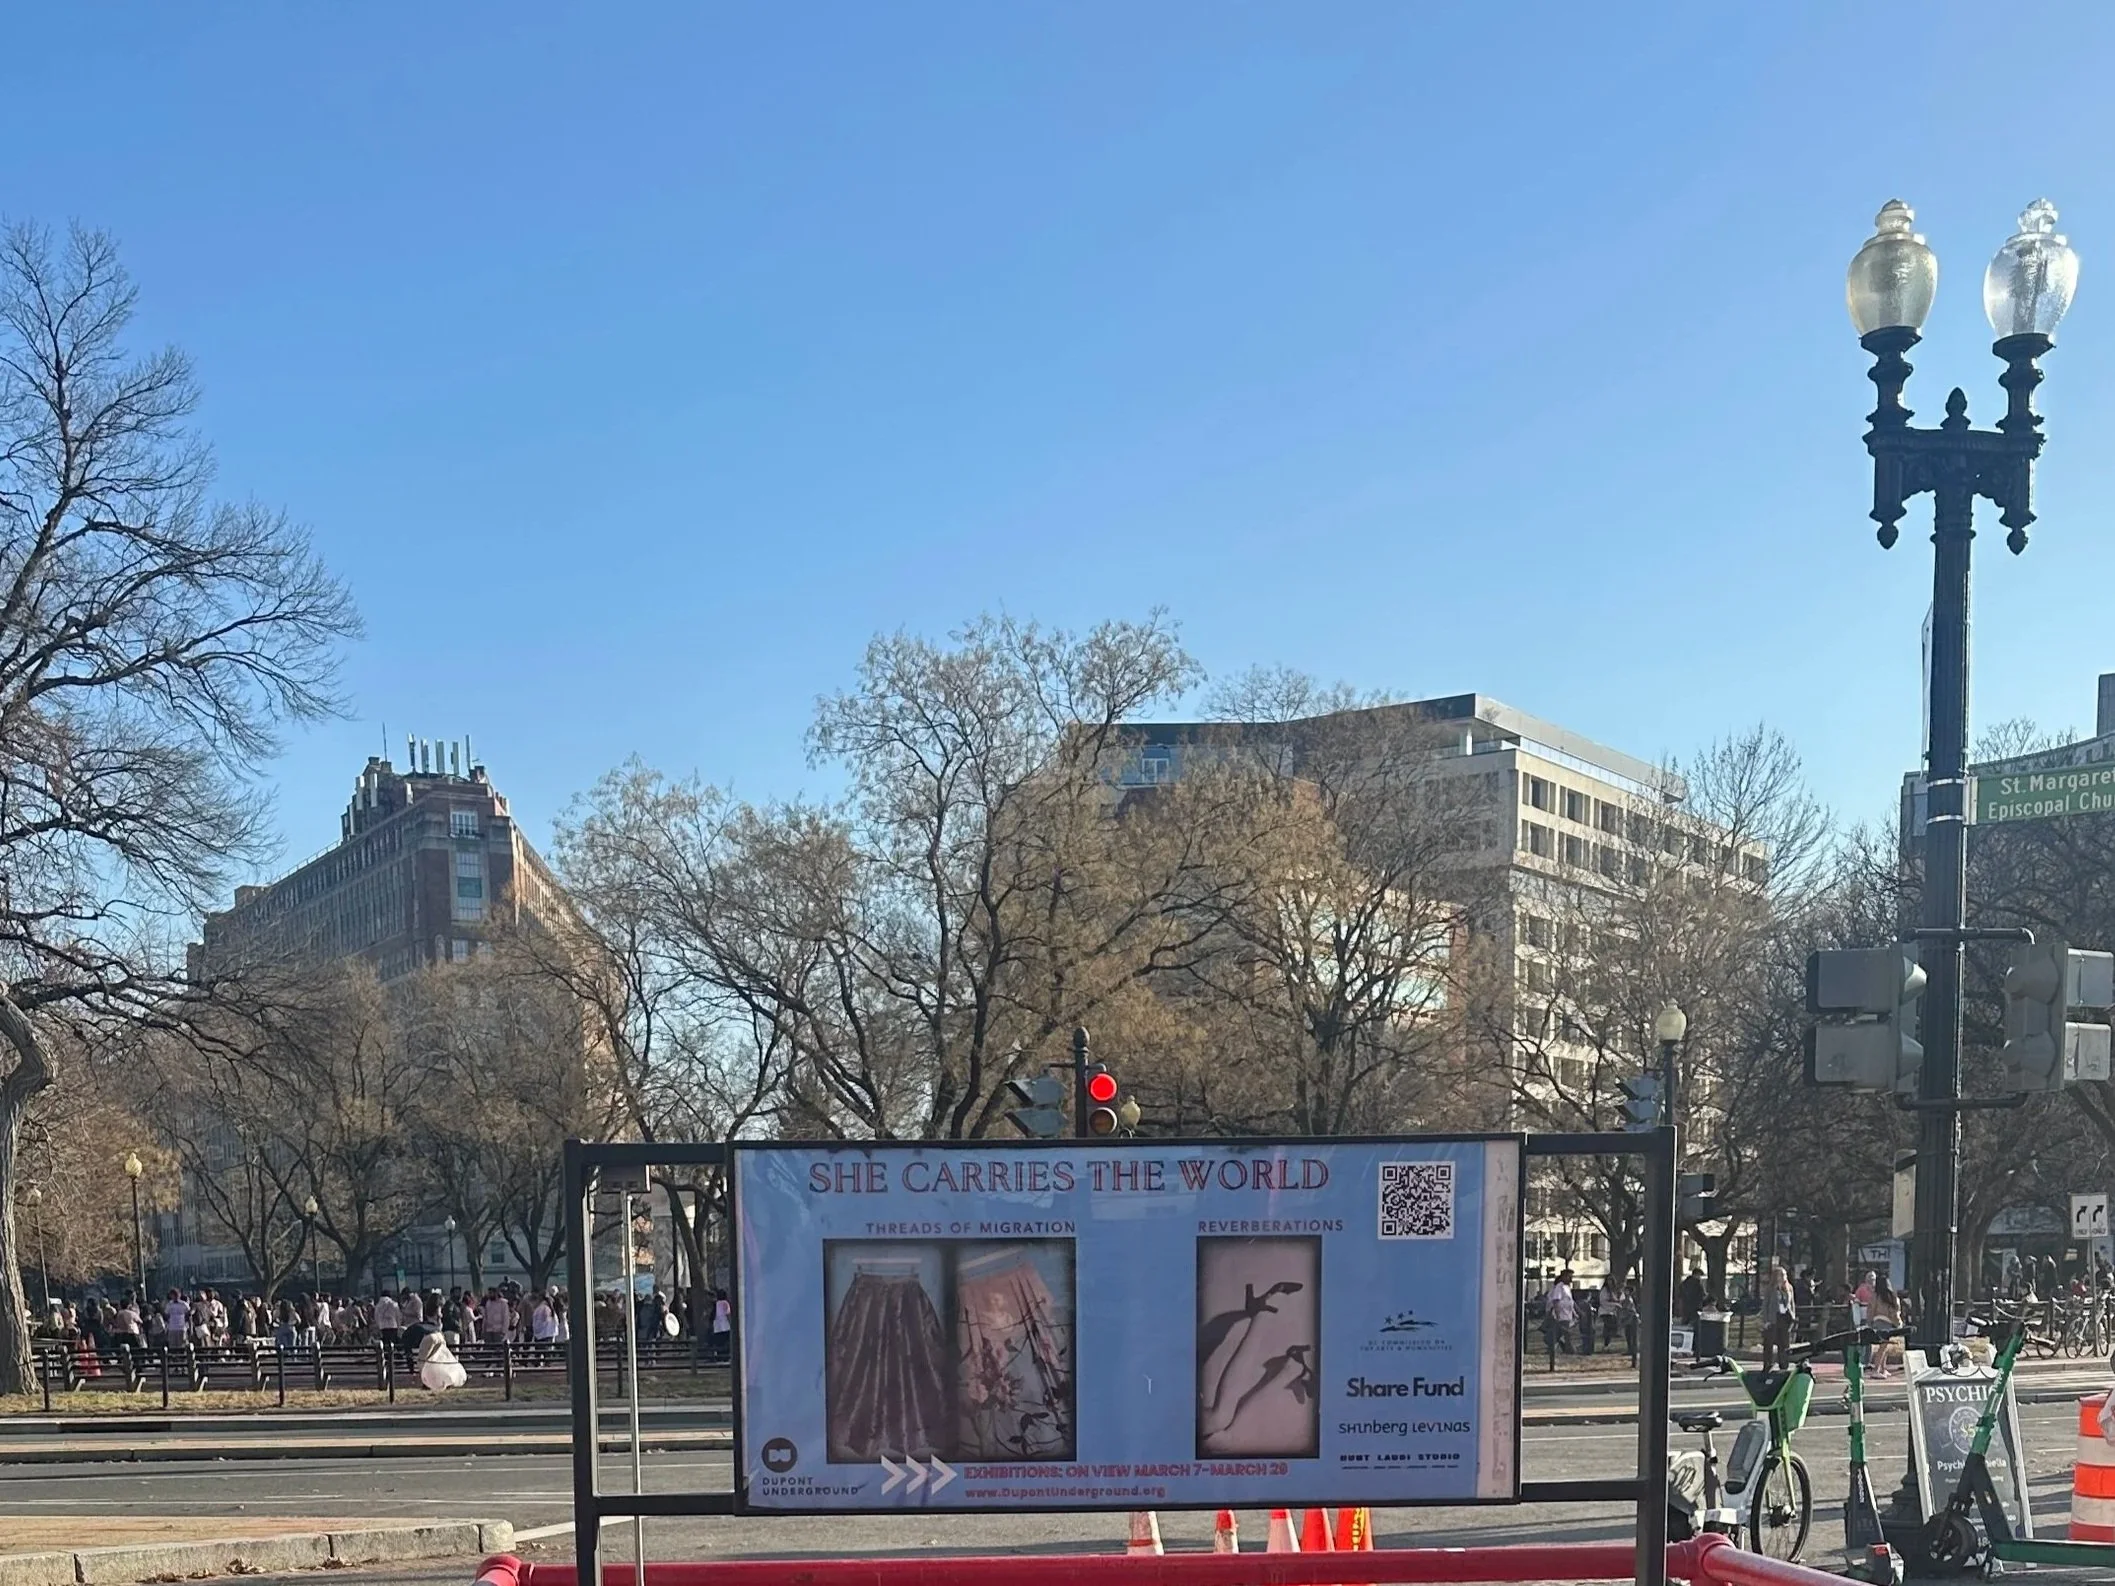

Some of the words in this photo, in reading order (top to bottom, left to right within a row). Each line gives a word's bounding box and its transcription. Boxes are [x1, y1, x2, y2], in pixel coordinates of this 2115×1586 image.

[2000, 777, 2026, 796] St.
[1988, 794, 2070, 822] Episcopal
[2079, 791, 2115, 810] Chu
[808, 1161, 889, 1194] SHE
[901, 1160, 1076, 1193] CARRIES
[1087, 1159, 1166, 1192] THE
[1178, 1158, 1330, 1191] WORLD
[866, 1222, 942, 1235] THREADS
[950, 1222, 971, 1235] OF
[979, 1220, 1076, 1234] MIGRATION
[1198, 1219, 1344, 1233] REVERBERATIONS
[1346, 1377, 1409, 1398] Share
[1413, 1376, 1465, 1397] Fund
[963, 1465, 1063, 1480] EXHIBITIONS:
[1066, 1465, 1089, 1479] ON
[1091, 1464, 1132, 1479] VIEW
[1134, 1463, 1190, 1478] MARCH
[762, 1476, 813, 1486] DUPONT
[763, 1487, 858, 1496] UNDERGROUND
